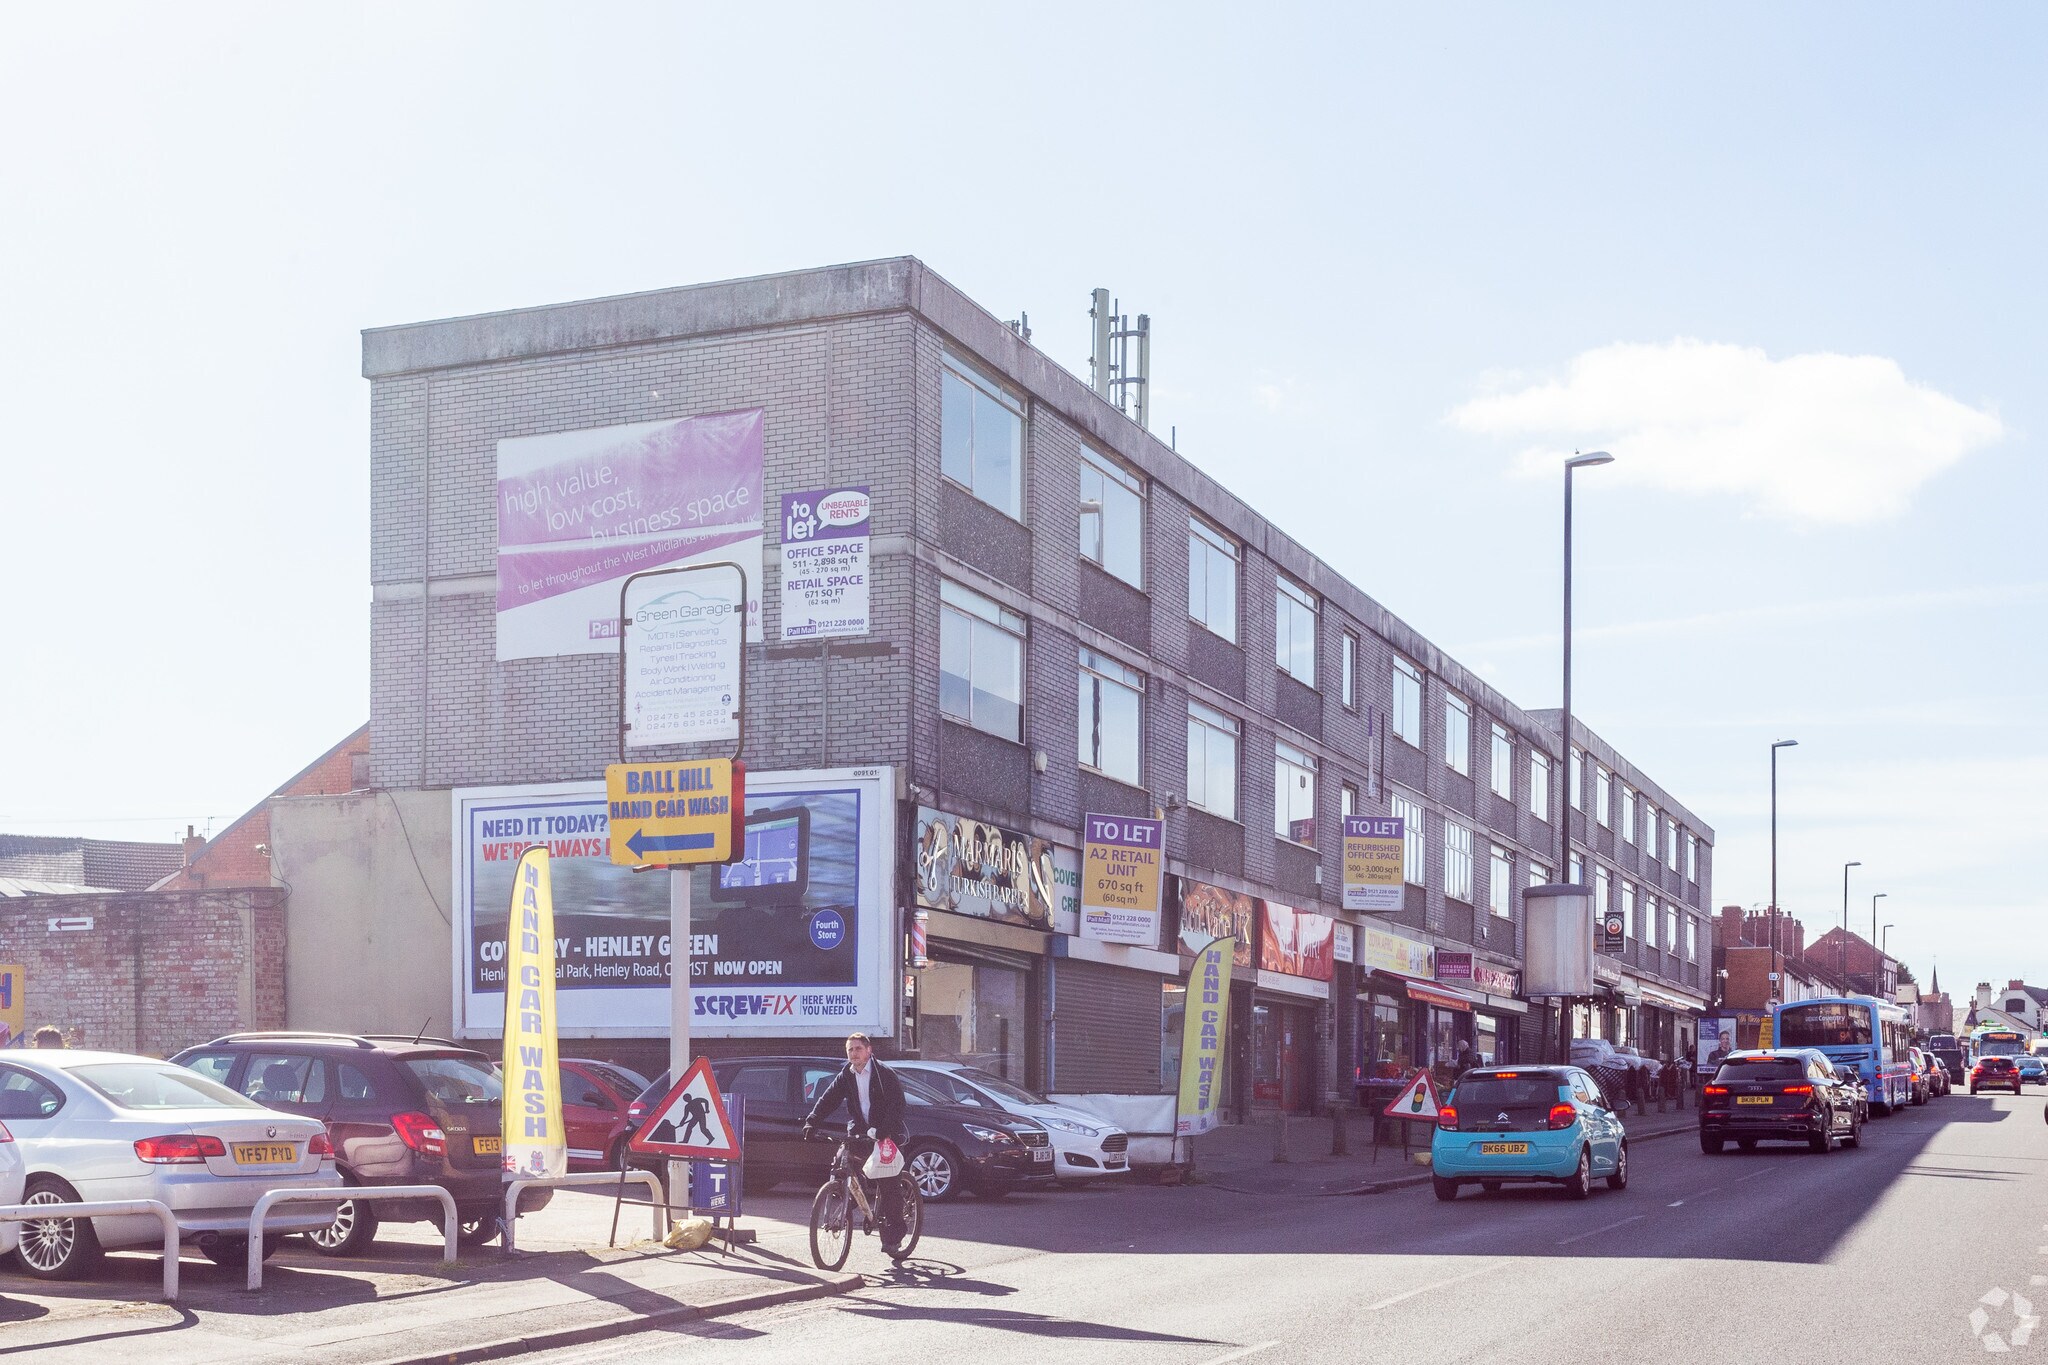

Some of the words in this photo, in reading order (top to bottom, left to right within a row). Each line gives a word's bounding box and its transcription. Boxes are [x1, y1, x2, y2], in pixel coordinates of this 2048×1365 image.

[505, 481, 551, 515] high
[557, 466, 618, 497] value,
[546, 505, 584, 532] low
[591, 486, 641, 518] cost,
[686, 486, 749, 524] space
[791, 500, 811, 518] to
[821, 498, 868, 510] UNBEATABLE
[829, 508, 860, 519] RENTS
[787, 514, 817, 540] let
[787, 546, 824, 559] OFFICE
[827, 543, 864, 556] SPACE
[518, 584, 529, 595] to
[531, 579, 543, 591] let
[546, 562, 602, 586] throughout
[603, 556, 620, 569] the
[622, 548, 648, 563] West
[650, 534, 697, 555] Midlands
[792, 559, 807, 568] 511
[814, 556, 836, 567] 2,898
[838, 557, 849, 565] sq
[850, 555, 858, 563] ft
[799, 568, 809, 576] (45
[840, 564, 850, 572] m)
[787, 578, 824, 591] RETAIL
[827, 574, 864, 588] SPACE
[804, 590, 819, 599] 671
[821, 588, 833, 598] SQ
[834, 588, 845, 596] FT
[808, 598, 819, 606] (62
[830, 597, 841, 605] m)
[636, 610, 678, 623] Green
[680, 603, 732, 617] Garage
[592, 620, 618, 638] Pall
[788, 628, 800, 636] Pall
[801, 625, 816, 635] Mall
[834, 619, 847, 627] 228
[650, 655, 674, 665] Tyres
[679, 651, 717, 661] Tracking
[640, 667, 662, 677] Body
[650, 676, 662, 685] Air
[662, 673, 716, 685] Conditioning
[635, 688, 673, 698] Accident
[673, 683, 731, 695] Management
[699, 709, 727, 718] 2233
[626, 770, 675, 794] BALL
[678, 767, 713, 792] HILL
[609, 800, 653, 820] HAND
[655, 799, 686, 819] CAR
[688, 795, 729, 817] WASH
[482, 819, 524, 838] NEED
[527, 817, 543, 836] IT
[545, 814, 608, 835] TODAY?
[1093, 821, 1119, 840] TO
[1123, 824, 1155, 843] LET
[1350, 820, 1370, 834] TO
[1374, 821, 1398, 835] LET
[953, 833, 1024, 874] MARMARIS
[1347, 843, 1401, 852] REFURBISHED
[1347, 851, 1374, 859] OFFICE
[1376, 852, 1400, 860] SPACE
[1090, 847, 1108, 860] A2
[1111, 849, 1155, 865] RETAIL
[1106, 864, 1138, 877] UNIT
[1366, 865, 1384, 873] 3,000
[952, 875, 992, 900] TURKISH
[993, 884, 1029, 909] BARBER
[1098, 879, 1118, 890] 670
[1120, 883, 1132, 894] sq
[1134, 881, 1144, 893] ft
[1103, 893, 1116, 903] (60
[1116, 896, 1126, 905] sq
[1127, 896, 1138, 905] m)
[522, 862, 540, 955] HAND
[815, 920, 839, 930] Fourth
[817, 930, 837, 940] Store
[585, 936, 654, 958] HENLEY
[566, 965, 593, 979] Park,
[594, 962, 631, 980] Henley
[633, 962, 662, 979] Road,
[714, 961, 746, 976] NOW
[748, 960, 783, 975] OPEN
[1202, 950, 1221, 1004] HAND
[519, 965, 542, 1034] CAR
[694, 994, 798, 1020] SCREWFIX
[802, 995, 824, 1005] HERE
[825, 994, 853, 1005] WHEN
[802, 1005, 820, 1016] YOU
[822, 1005, 844, 1016] NEED
[845, 1005, 858, 1015] US
[1200, 1010, 1219, 1050] CAR
[519, 1045, 548, 1138] WASH
[239, 1145, 268, 1163] YF57
[271, 1143, 293, 1161] PYD
[1482, 1145, 1506, 1153] BK66
[1507, 1144, 1526, 1153] UBZ
